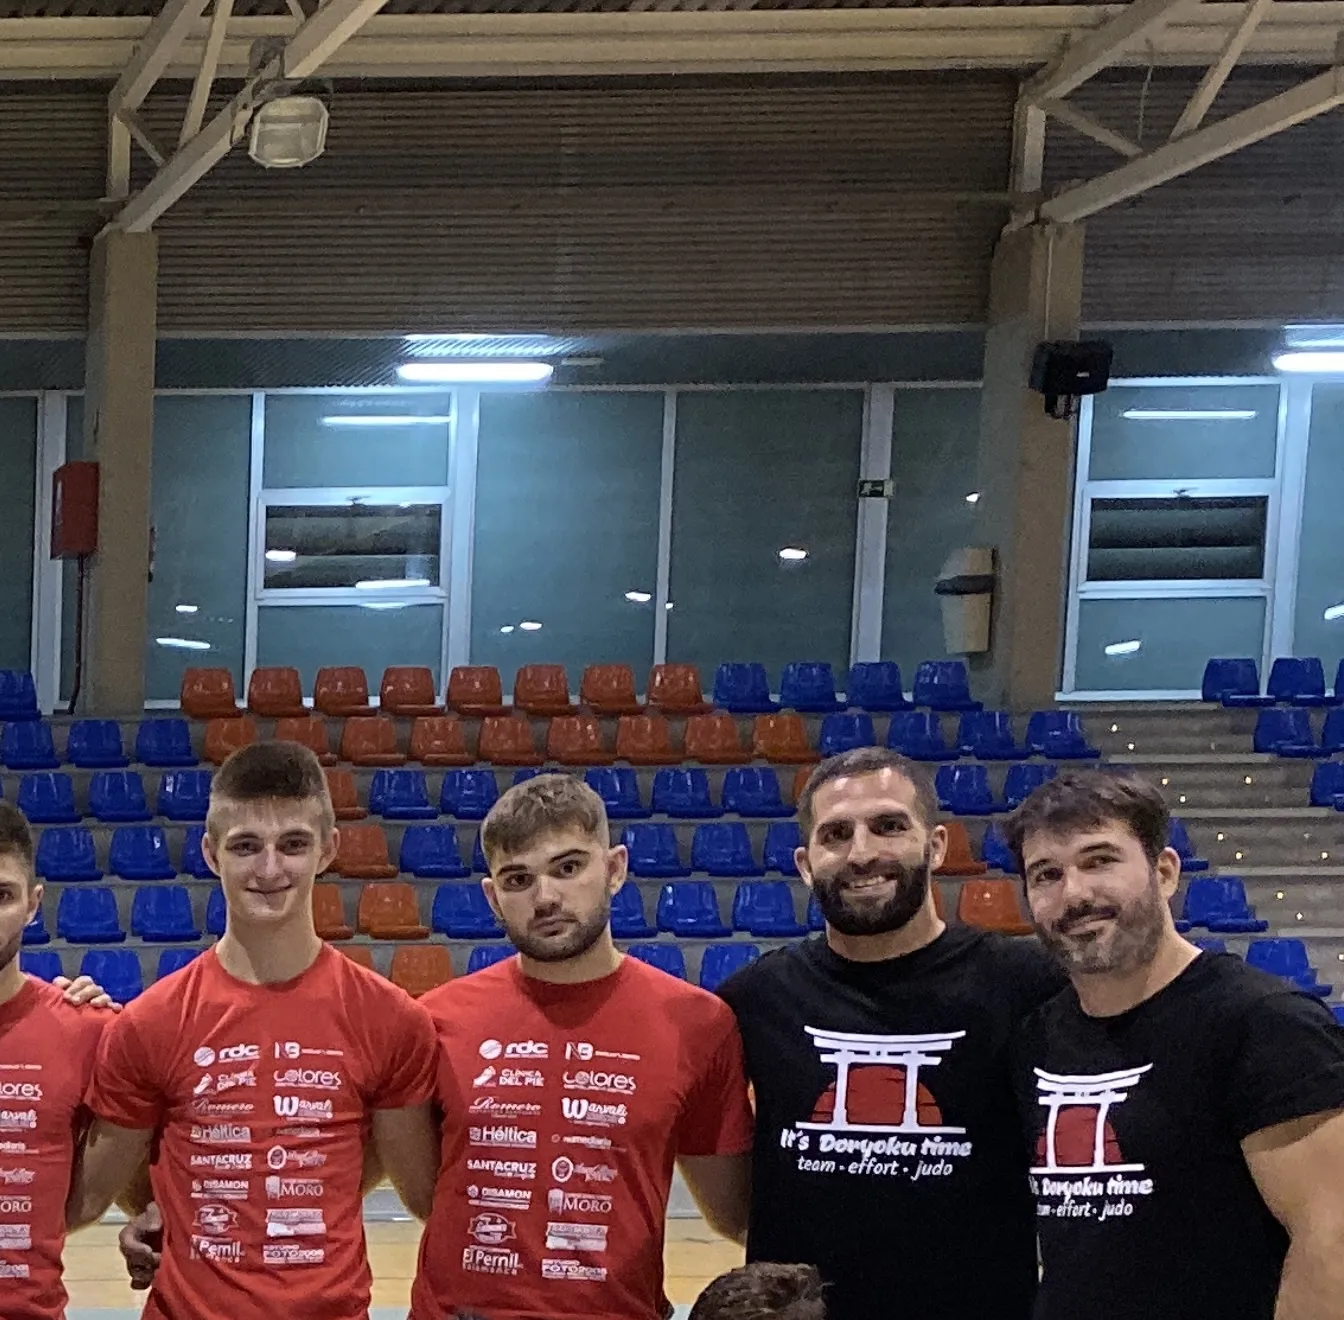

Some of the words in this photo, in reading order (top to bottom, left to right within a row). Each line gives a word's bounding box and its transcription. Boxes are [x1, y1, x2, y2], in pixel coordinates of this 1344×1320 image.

[219, 1043, 260, 1058] rdc
[506, 1041, 548, 1054] rdc
[780, 1128, 810, 1152] It's
[819, 1134, 916, 1161] Doryoku
[920, 1135, 972, 1157] time
[467, 1160, 537, 1174] SANTACRUZ
[797, 1157, 836, 1174] team
[847, 1157, 898, 1177] effort
[911, 1159, 953, 1181] judo
[1107, 1174, 1154, 1195] time
[563, 1199, 611, 1213] MORO
[1056, 1198, 1091, 1217] effort
[1098, 1200, 1134, 1220] judo
